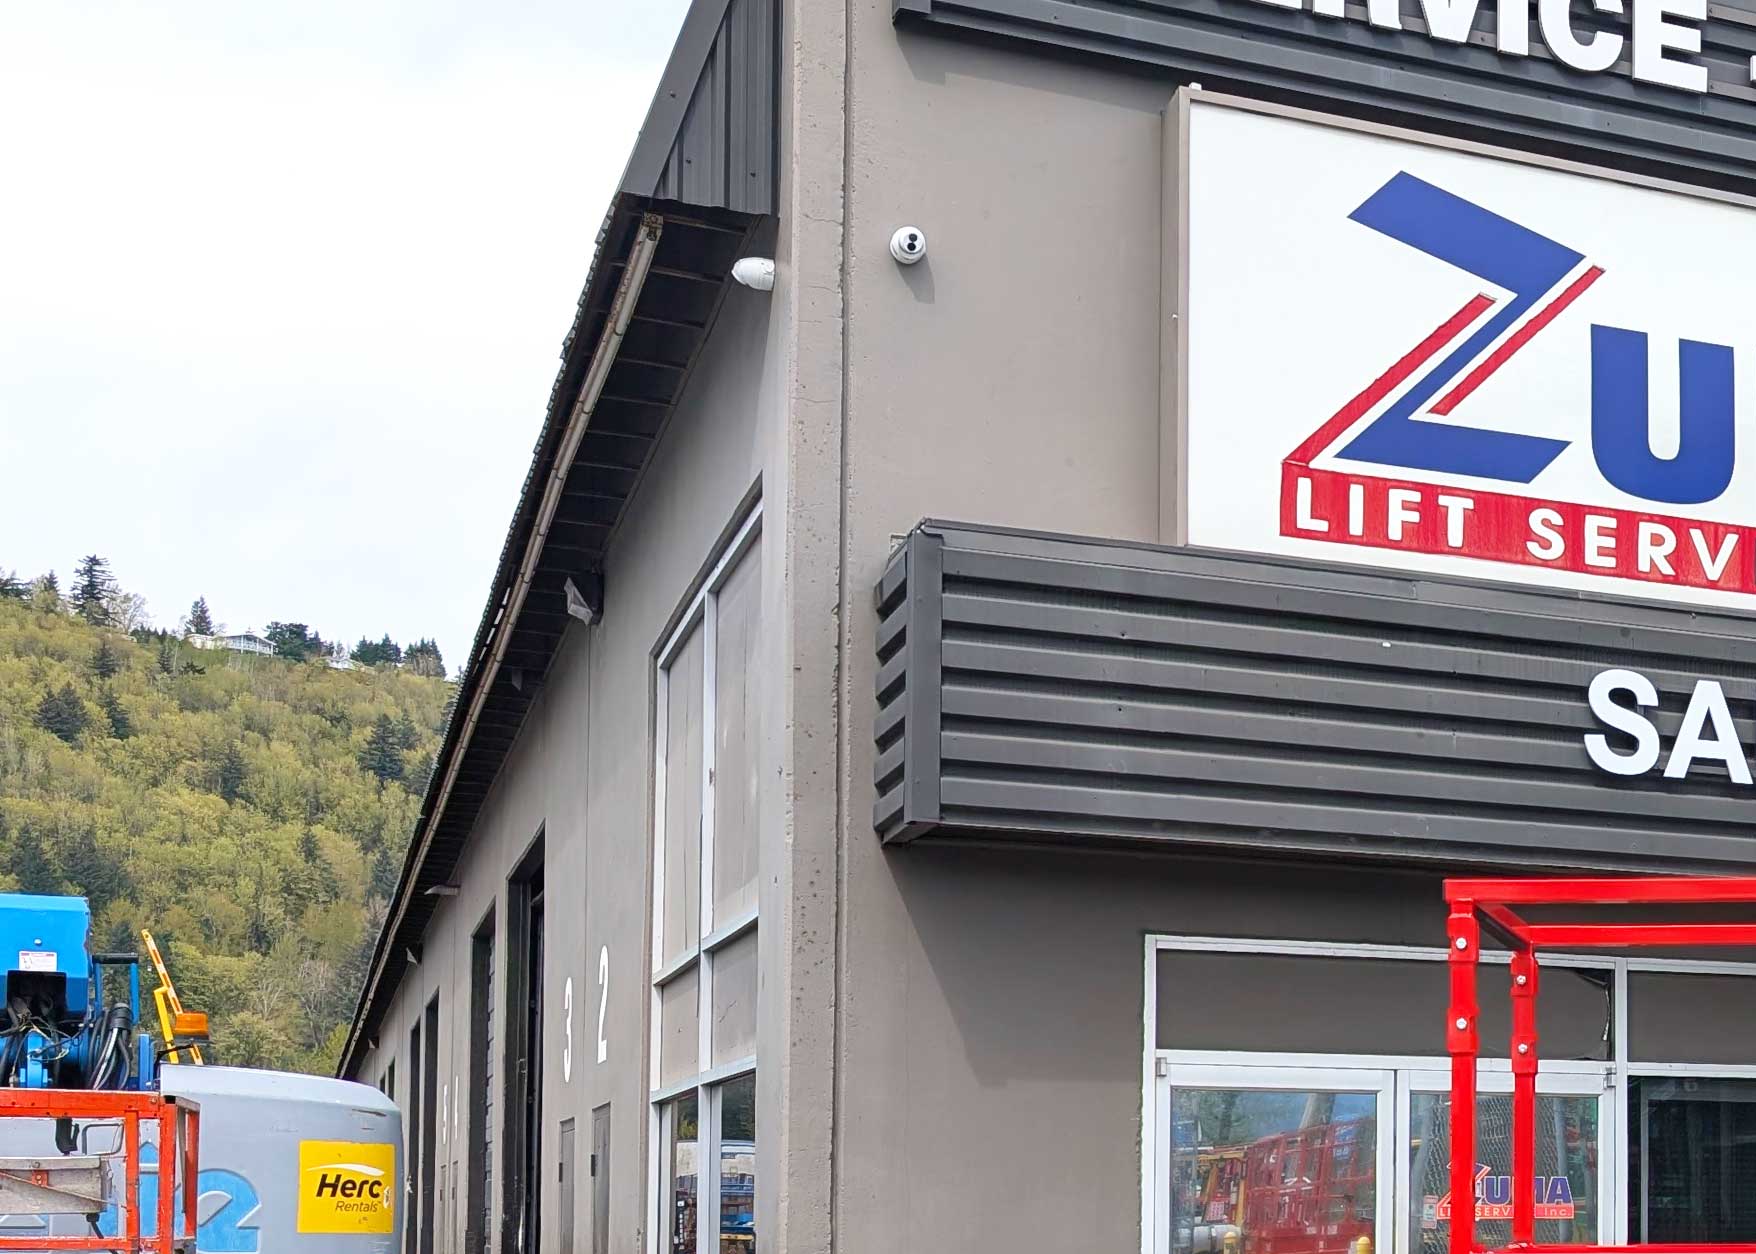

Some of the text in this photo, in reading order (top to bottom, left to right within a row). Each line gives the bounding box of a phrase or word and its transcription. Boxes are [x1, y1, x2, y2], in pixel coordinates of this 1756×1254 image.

[1294, 476, 1476, 549] LIFT
[562, 976, 573, 1083] 3
[597, 945, 610, 1064] 2
[315, 1173, 383, 1199] Herc
[335, 1200, 379, 1213] Rentals
